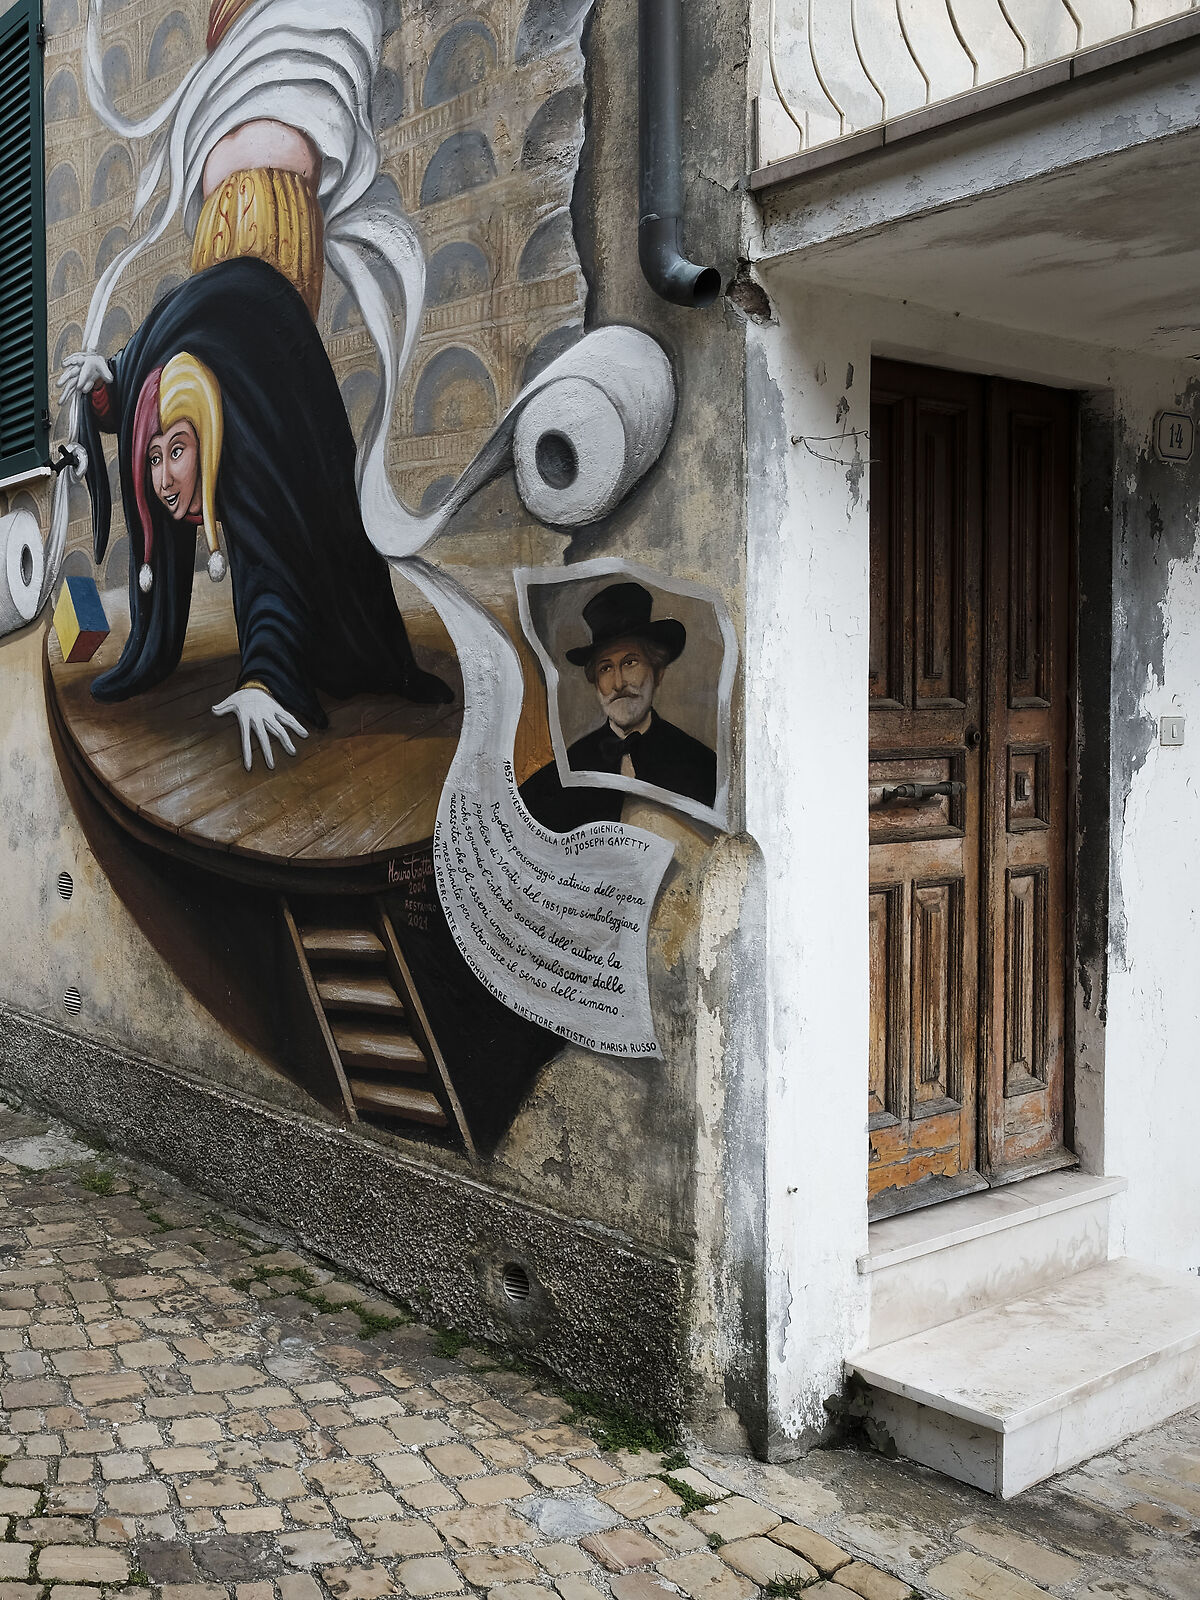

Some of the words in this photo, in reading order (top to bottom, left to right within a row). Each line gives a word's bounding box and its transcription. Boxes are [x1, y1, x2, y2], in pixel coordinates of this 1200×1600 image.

[1169, 423, 1184, 449] 14
[502, 760, 514, 784] 1857
[508, 786, 536, 832] INVENZIONE
[535, 828, 558, 846] DELLA
[561, 830, 586, 846] CARTA
[590, 825, 624, 835] IGIENICA
[455, 847, 467, 866] che
[564, 846, 573, 856] DI
[574, 837, 605, 856] JOSEPH
[607, 836, 650, 852] GAYETTY
[457, 866, 475, 884] gli
[472, 802, 491, 846] popolare
[489, 847, 500, 859] di
[496, 855, 521, 890] Verdi,
[522, 884, 542, 903] del
[541, 898, 561, 916] 1851,
[560, 906, 579, 920] per
[579, 906, 640, 933] simboleggiare
[508, 846, 555, 883] personaggio
[557, 872, 591, 893] satirico
[464, 825, 485, 869] seguendo
[514, 912, 547, 939] sociale
[607, 951, 623, 970] la
[469, 885, 492, 920] esseri
[434, 820, 443, 860] MURALE
[444, 905, 458, 933] ARTE
[455, 935, 467, 955] PER
[466, 954, 508, 1004] COMUNICARE
[513, 1002, 554, 1029] DIRETTORE
[555, 1025, 596, 1048] ARTISTICO
[600, 1041, 628, 1053] MARISA
[630, 1042, 657, 1053] RUSSO
[457, 903, 471, 921] per
[470, 921, 506, 966] ritrovare
[506, 959, 519, 973] il
[518, 969, 548, 989] senso
[489, 918, 516, 949] umani
[516, 944, 528, 956] si
[592, 972, 626, 995] dalle
